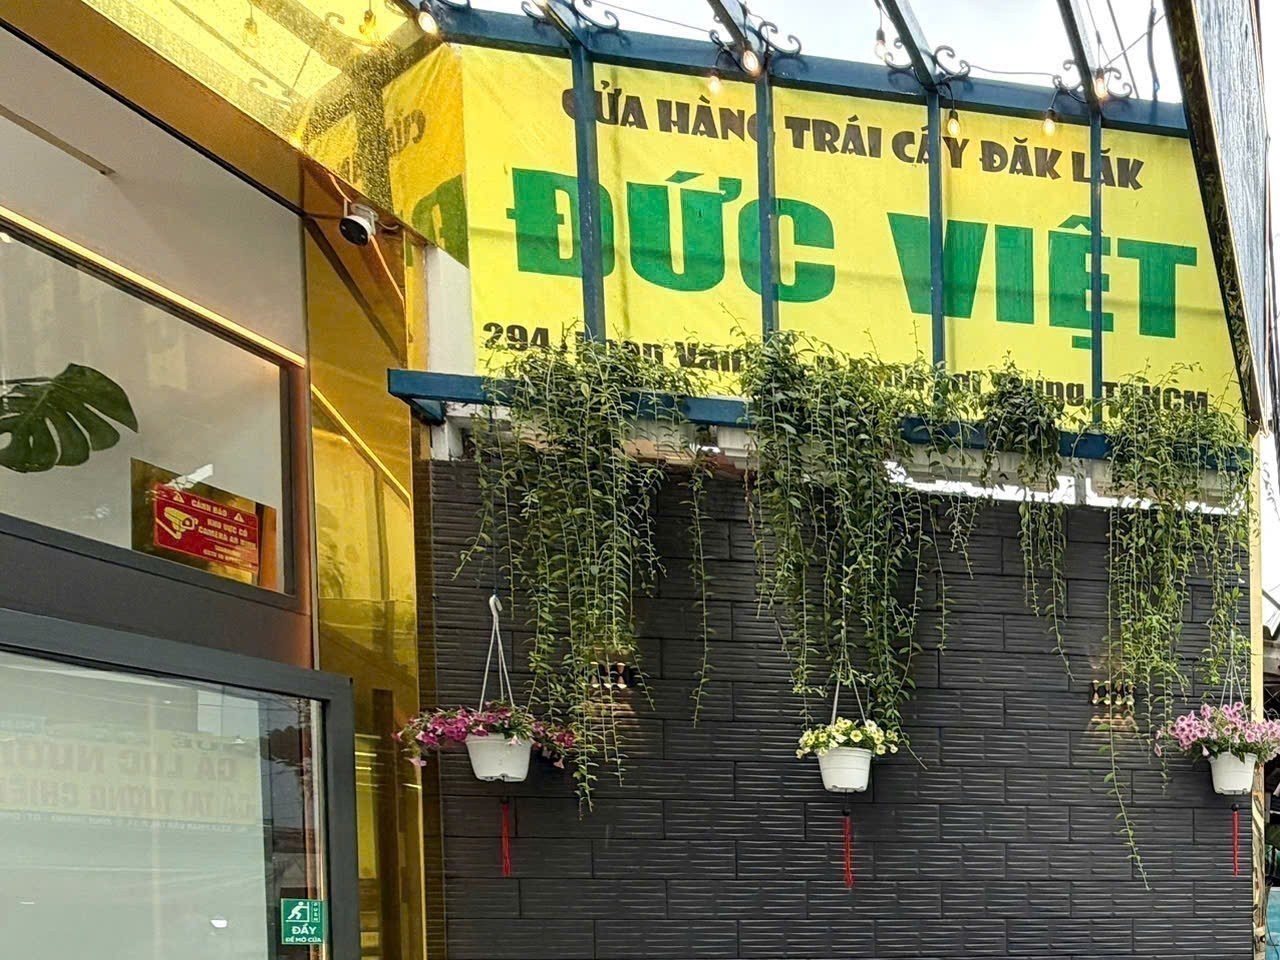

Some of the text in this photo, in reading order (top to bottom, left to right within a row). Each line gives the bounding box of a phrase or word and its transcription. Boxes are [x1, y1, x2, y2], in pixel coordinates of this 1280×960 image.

[784, 115, 882, 158] TRÁI
[506, 168, 1197, 350] ĐỨC VIỆT
